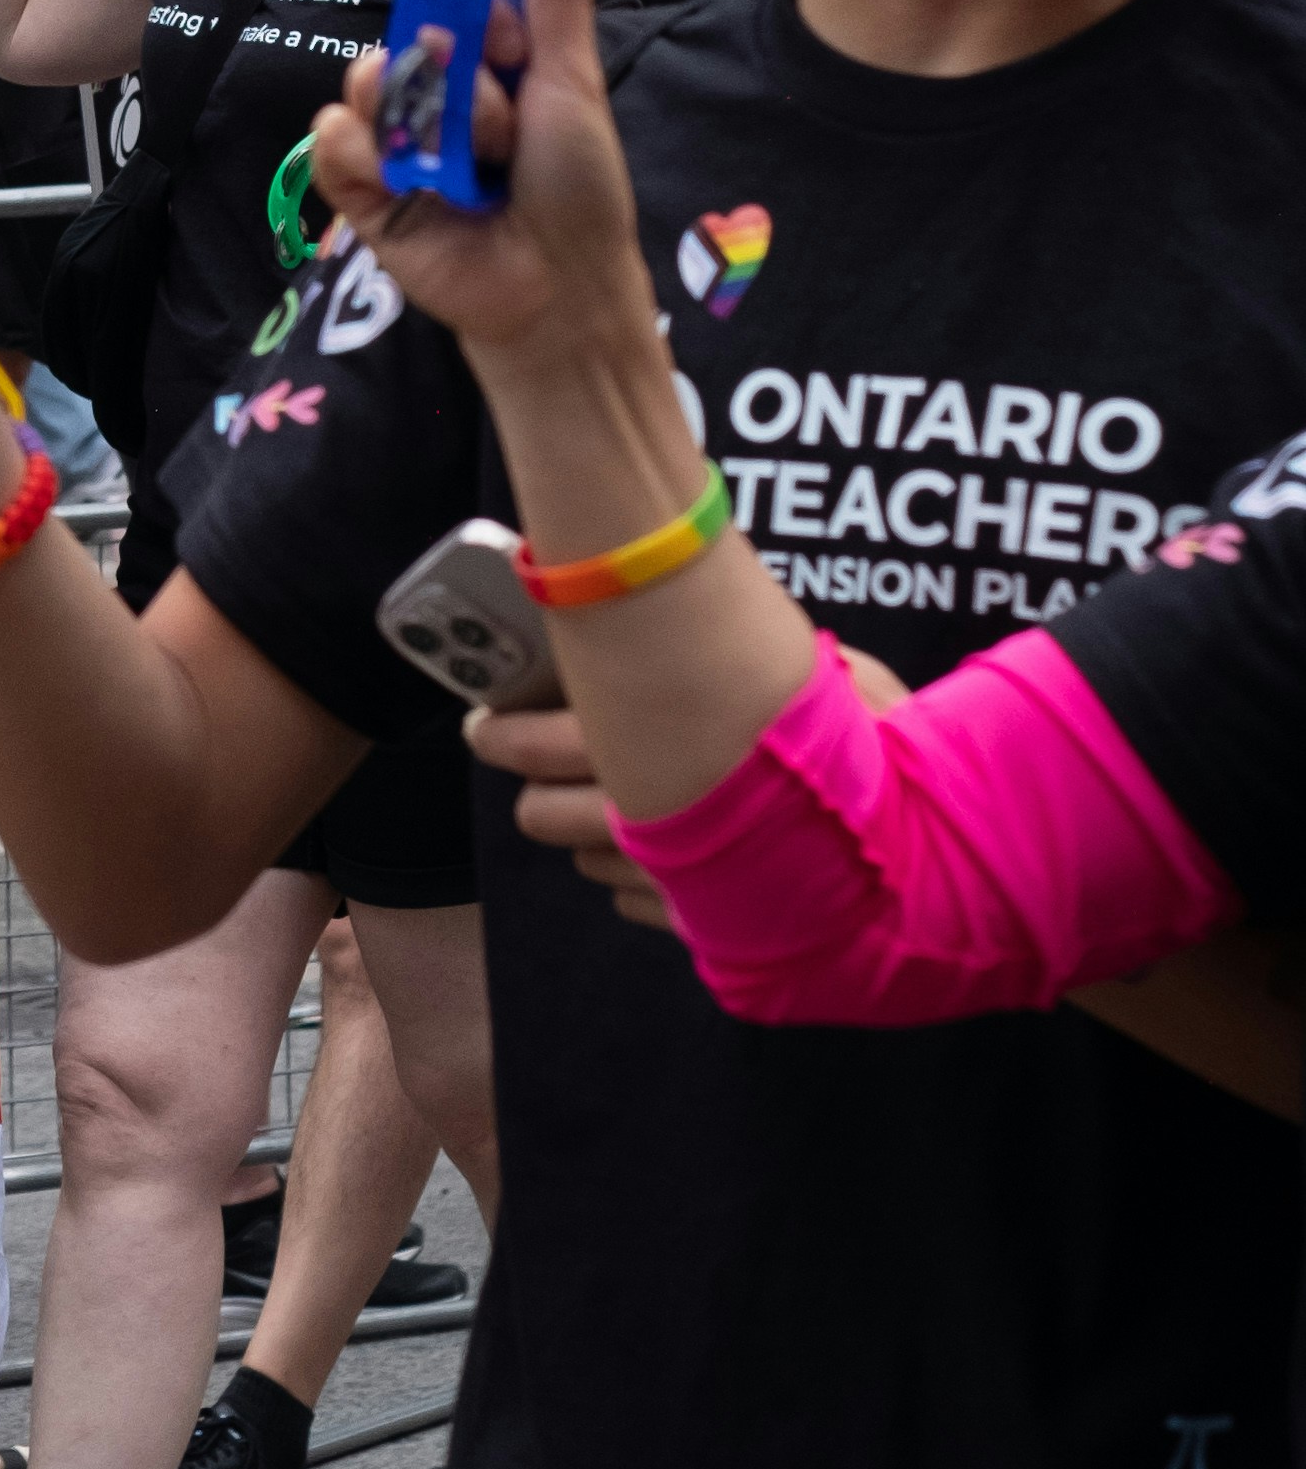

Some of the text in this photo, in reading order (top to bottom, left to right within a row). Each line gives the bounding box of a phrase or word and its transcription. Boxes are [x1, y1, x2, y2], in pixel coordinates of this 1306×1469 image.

[284, 30, 302, 48] a
[728, 368, 1164, 474] ONTARIO
[761, 551, 958, 613] ENSION
